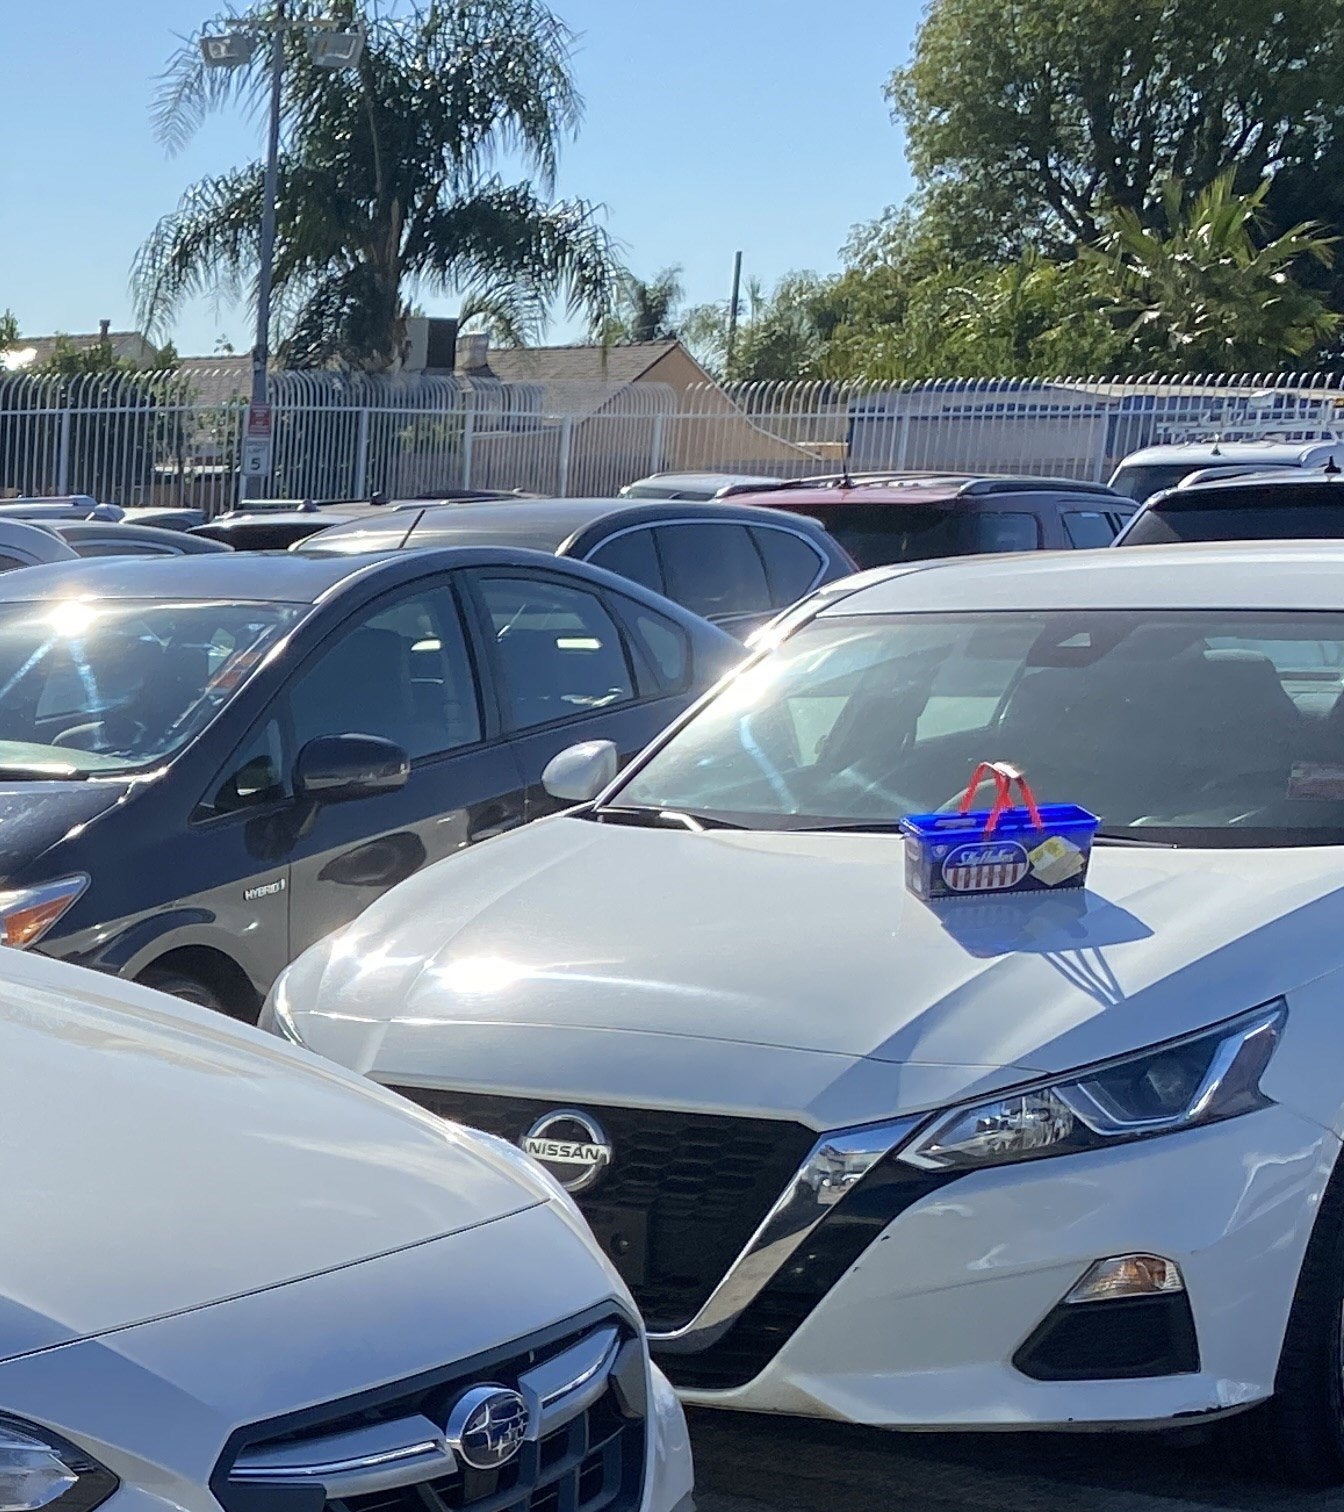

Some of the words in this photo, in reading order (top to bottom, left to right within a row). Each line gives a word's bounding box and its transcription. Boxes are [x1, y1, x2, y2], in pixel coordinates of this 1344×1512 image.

[251, 458, 261, 471] 5
[244, 881, 283, 901] HYBRID
[528, 1141, 601, 1160] NISSAN
